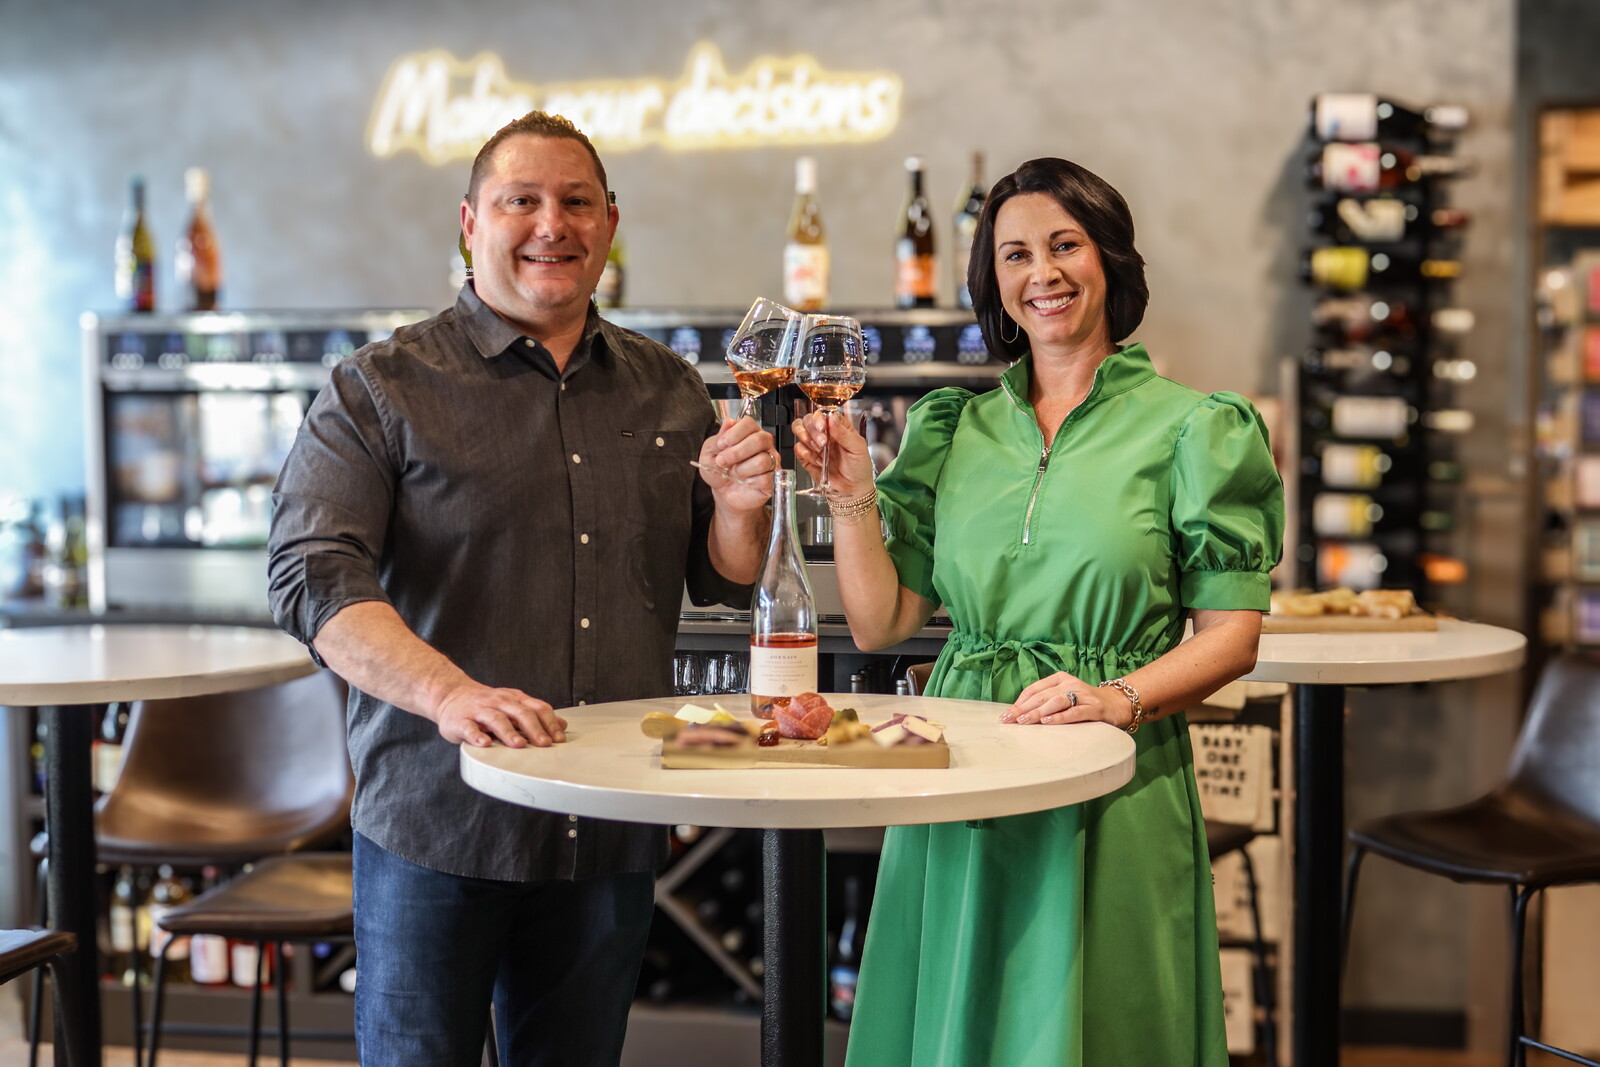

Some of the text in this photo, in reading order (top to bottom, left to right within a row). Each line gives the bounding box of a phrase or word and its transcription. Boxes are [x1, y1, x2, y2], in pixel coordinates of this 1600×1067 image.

[665, 49, 898, 143] decisions
[1202, 735, 1242, 748] BABY
[1206, 751, 1240, 765] ONE
[1197, 768, 1246, 782] MORE
[1202, 782, 1241, 797] TIME
